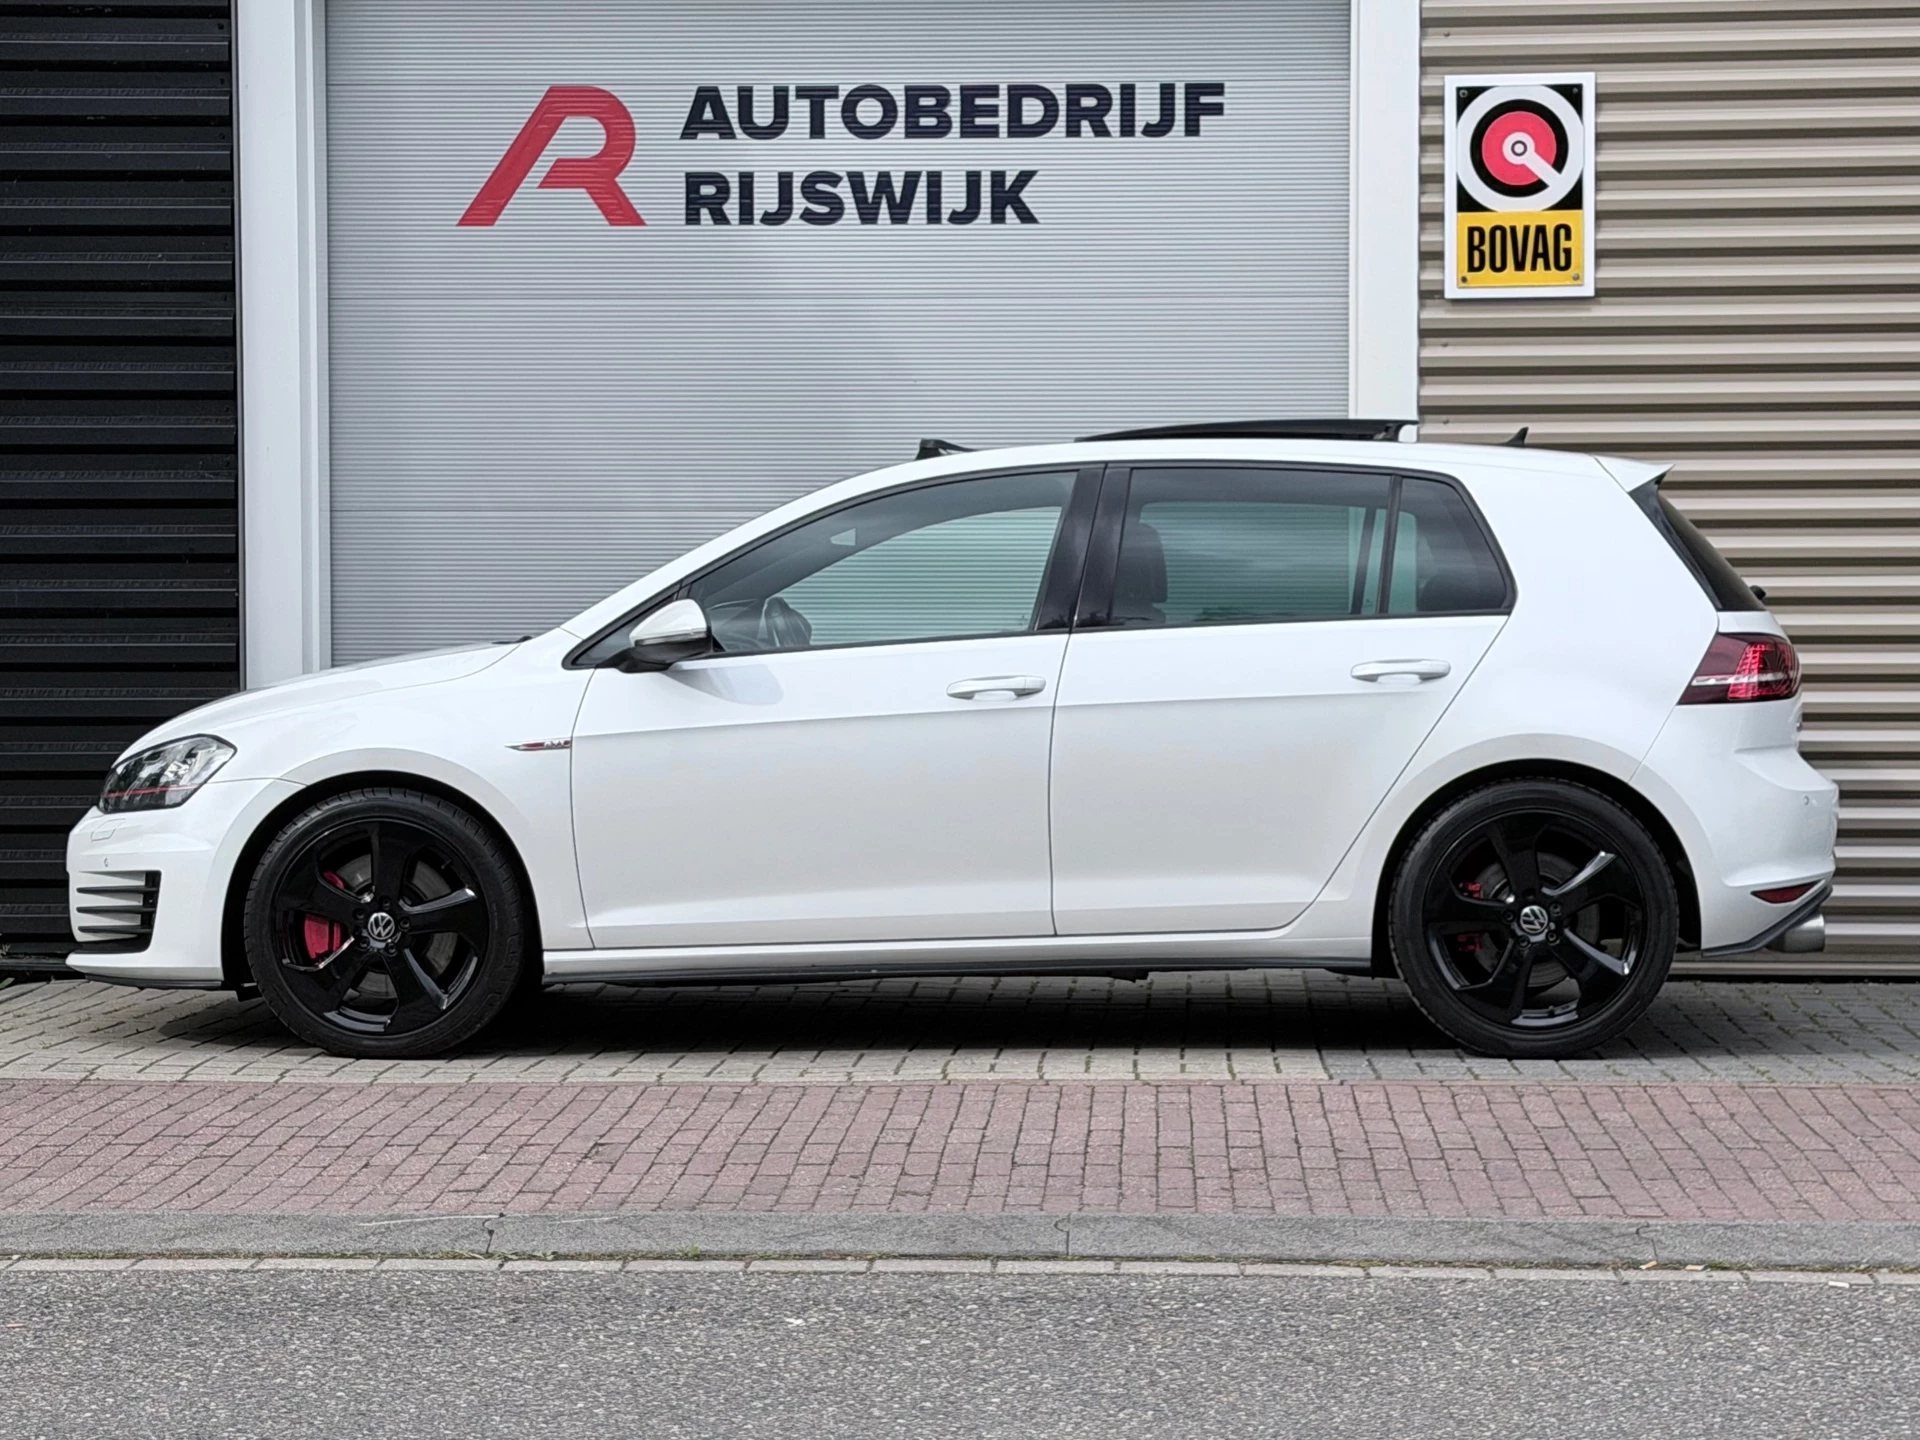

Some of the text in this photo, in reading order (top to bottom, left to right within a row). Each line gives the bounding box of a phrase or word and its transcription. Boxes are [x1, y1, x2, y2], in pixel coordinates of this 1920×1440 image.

[681, 83, 1225, 139] AUTOBEDRIJF
[685, 170, 1039, 226] RIJSWIJK
[1467, 223, 1572, 273] BOVAG
